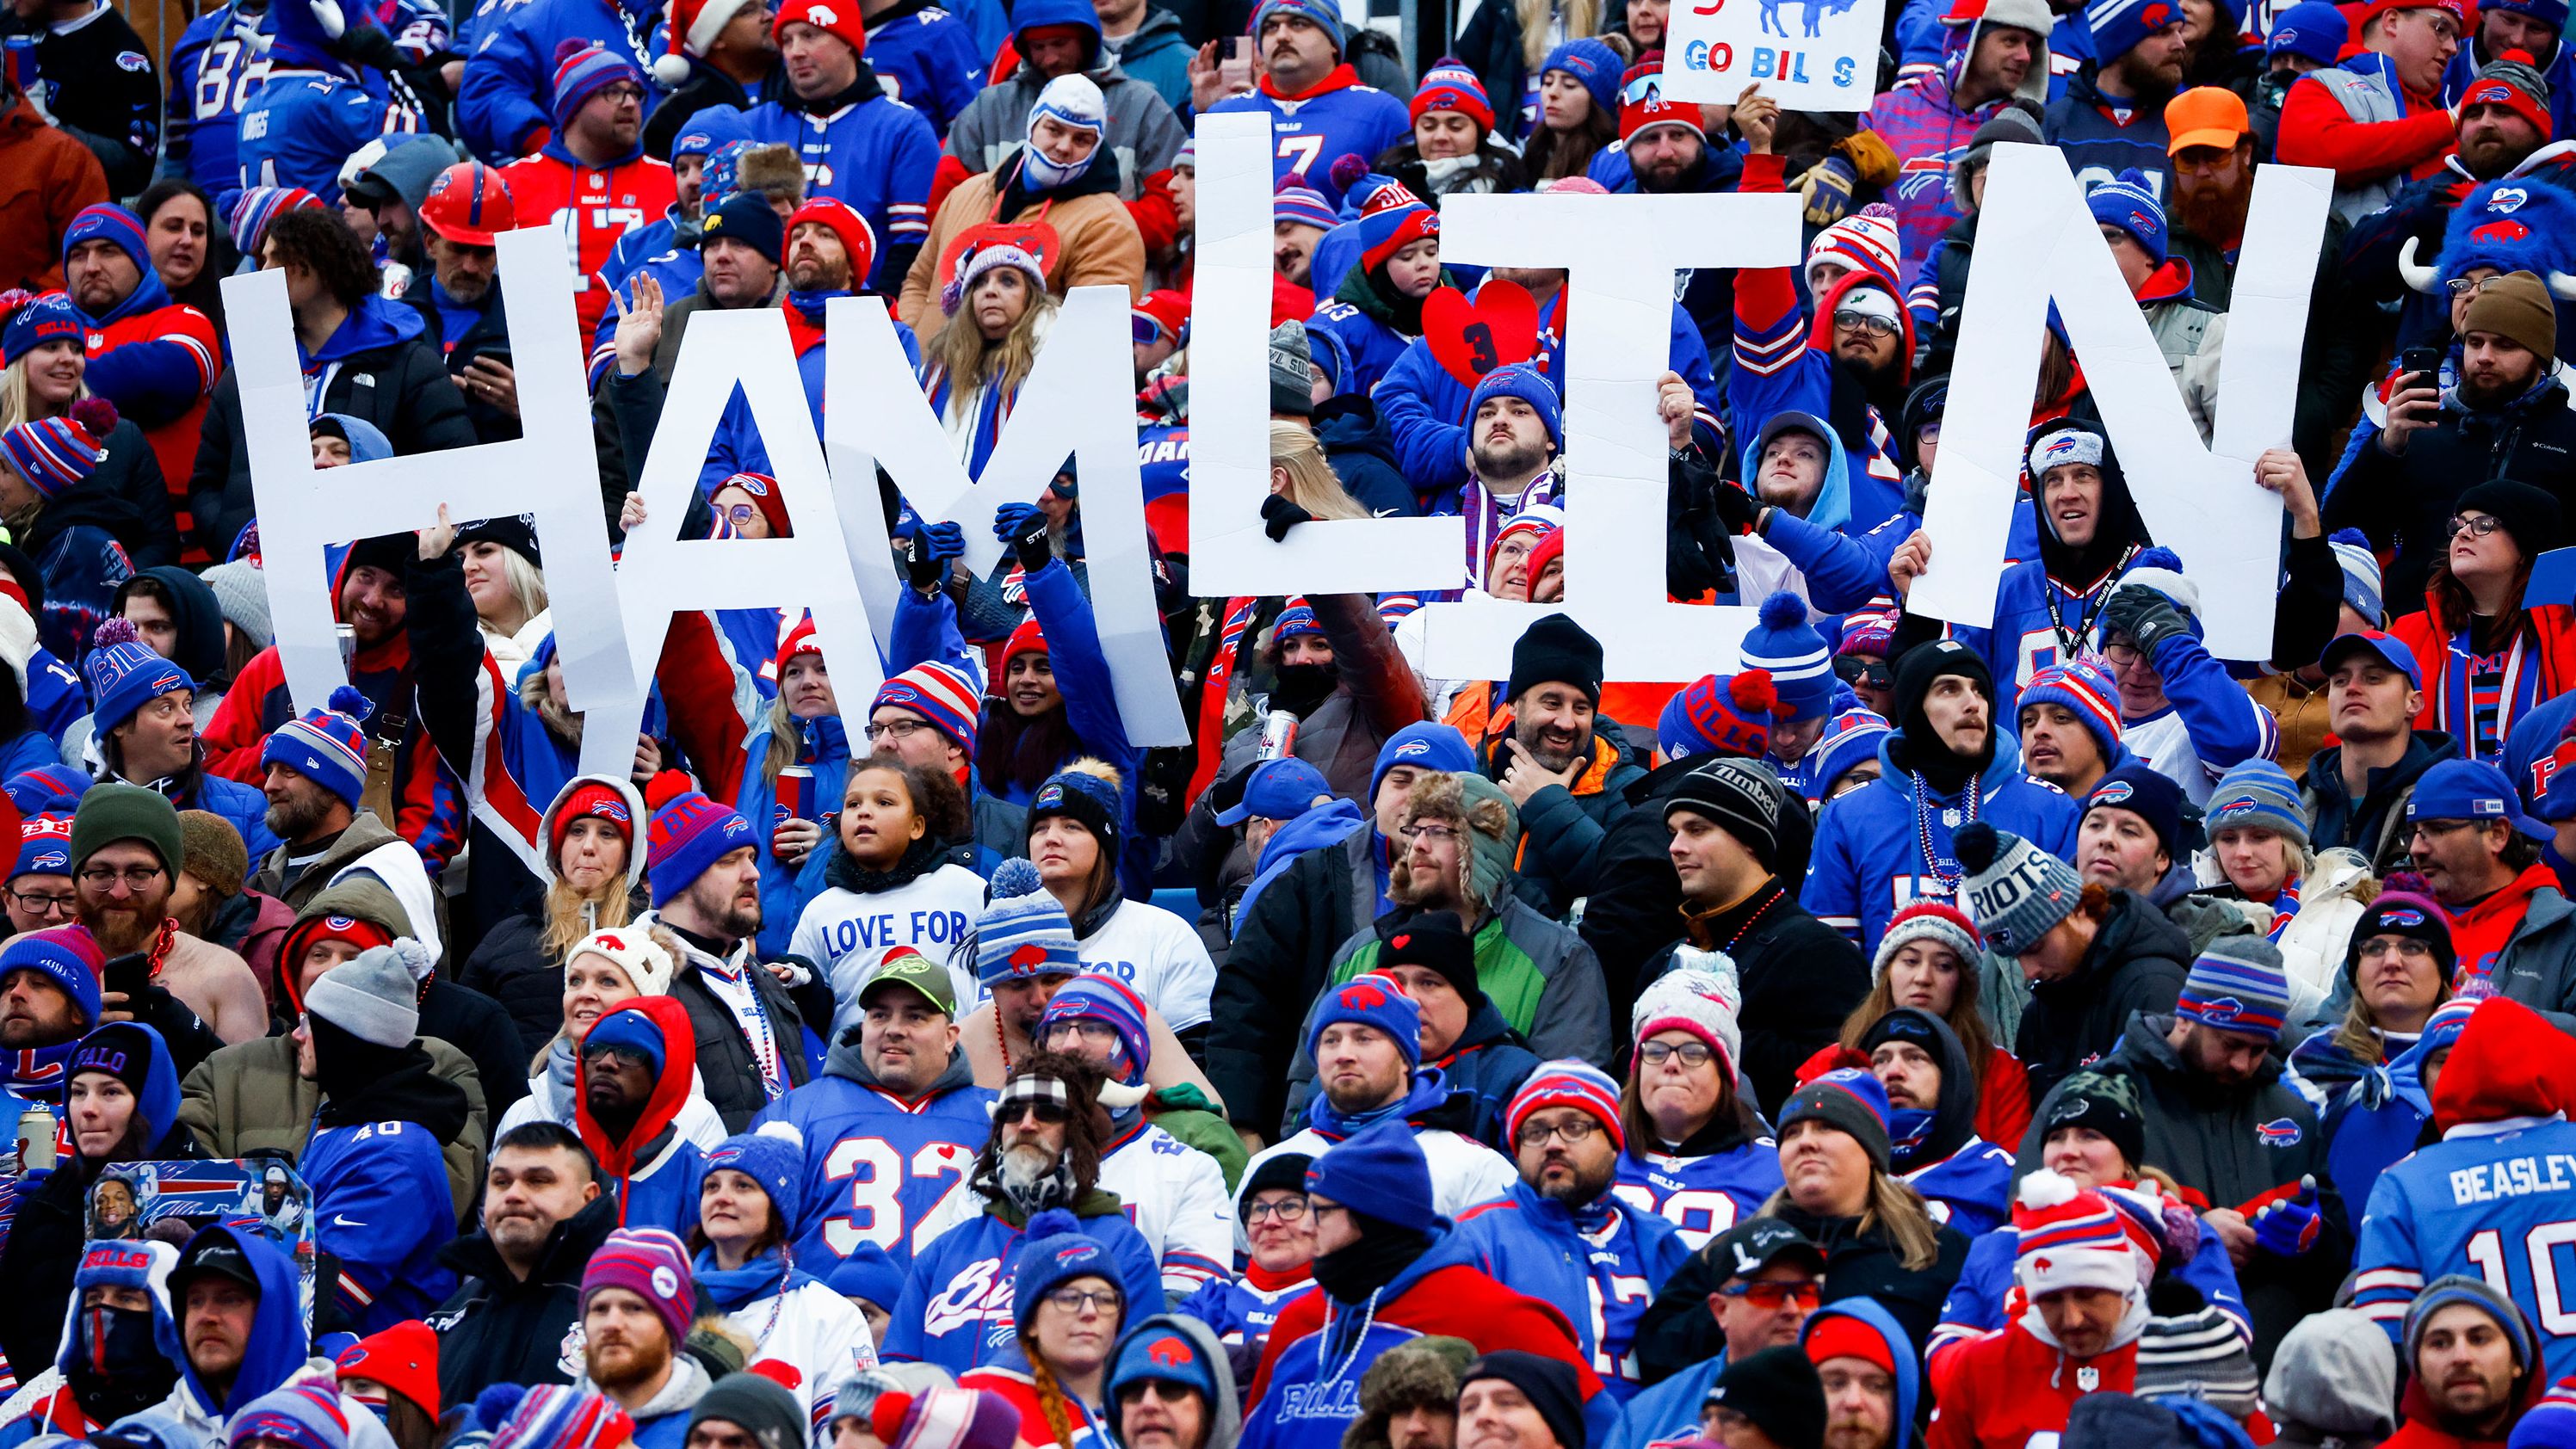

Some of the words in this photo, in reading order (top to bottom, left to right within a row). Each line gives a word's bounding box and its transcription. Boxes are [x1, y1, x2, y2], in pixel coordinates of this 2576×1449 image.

[1684, 40, 1733, 73] GO
[1464, 322, 1500, 371] 3
[2539, 442, 2567, 454] Columbia
[1689, 684, 1768, 753] BILLS
[1969, 848, 2053, 922] RIOTS
[822, 914, 895, 959] LOVE
[911, 910, 967, 947] FOR
[139, 1164, 158, 1199] 3
[824, 1137, 980, 1257] 32
[83, 1250, 149, 1269] BILLS
